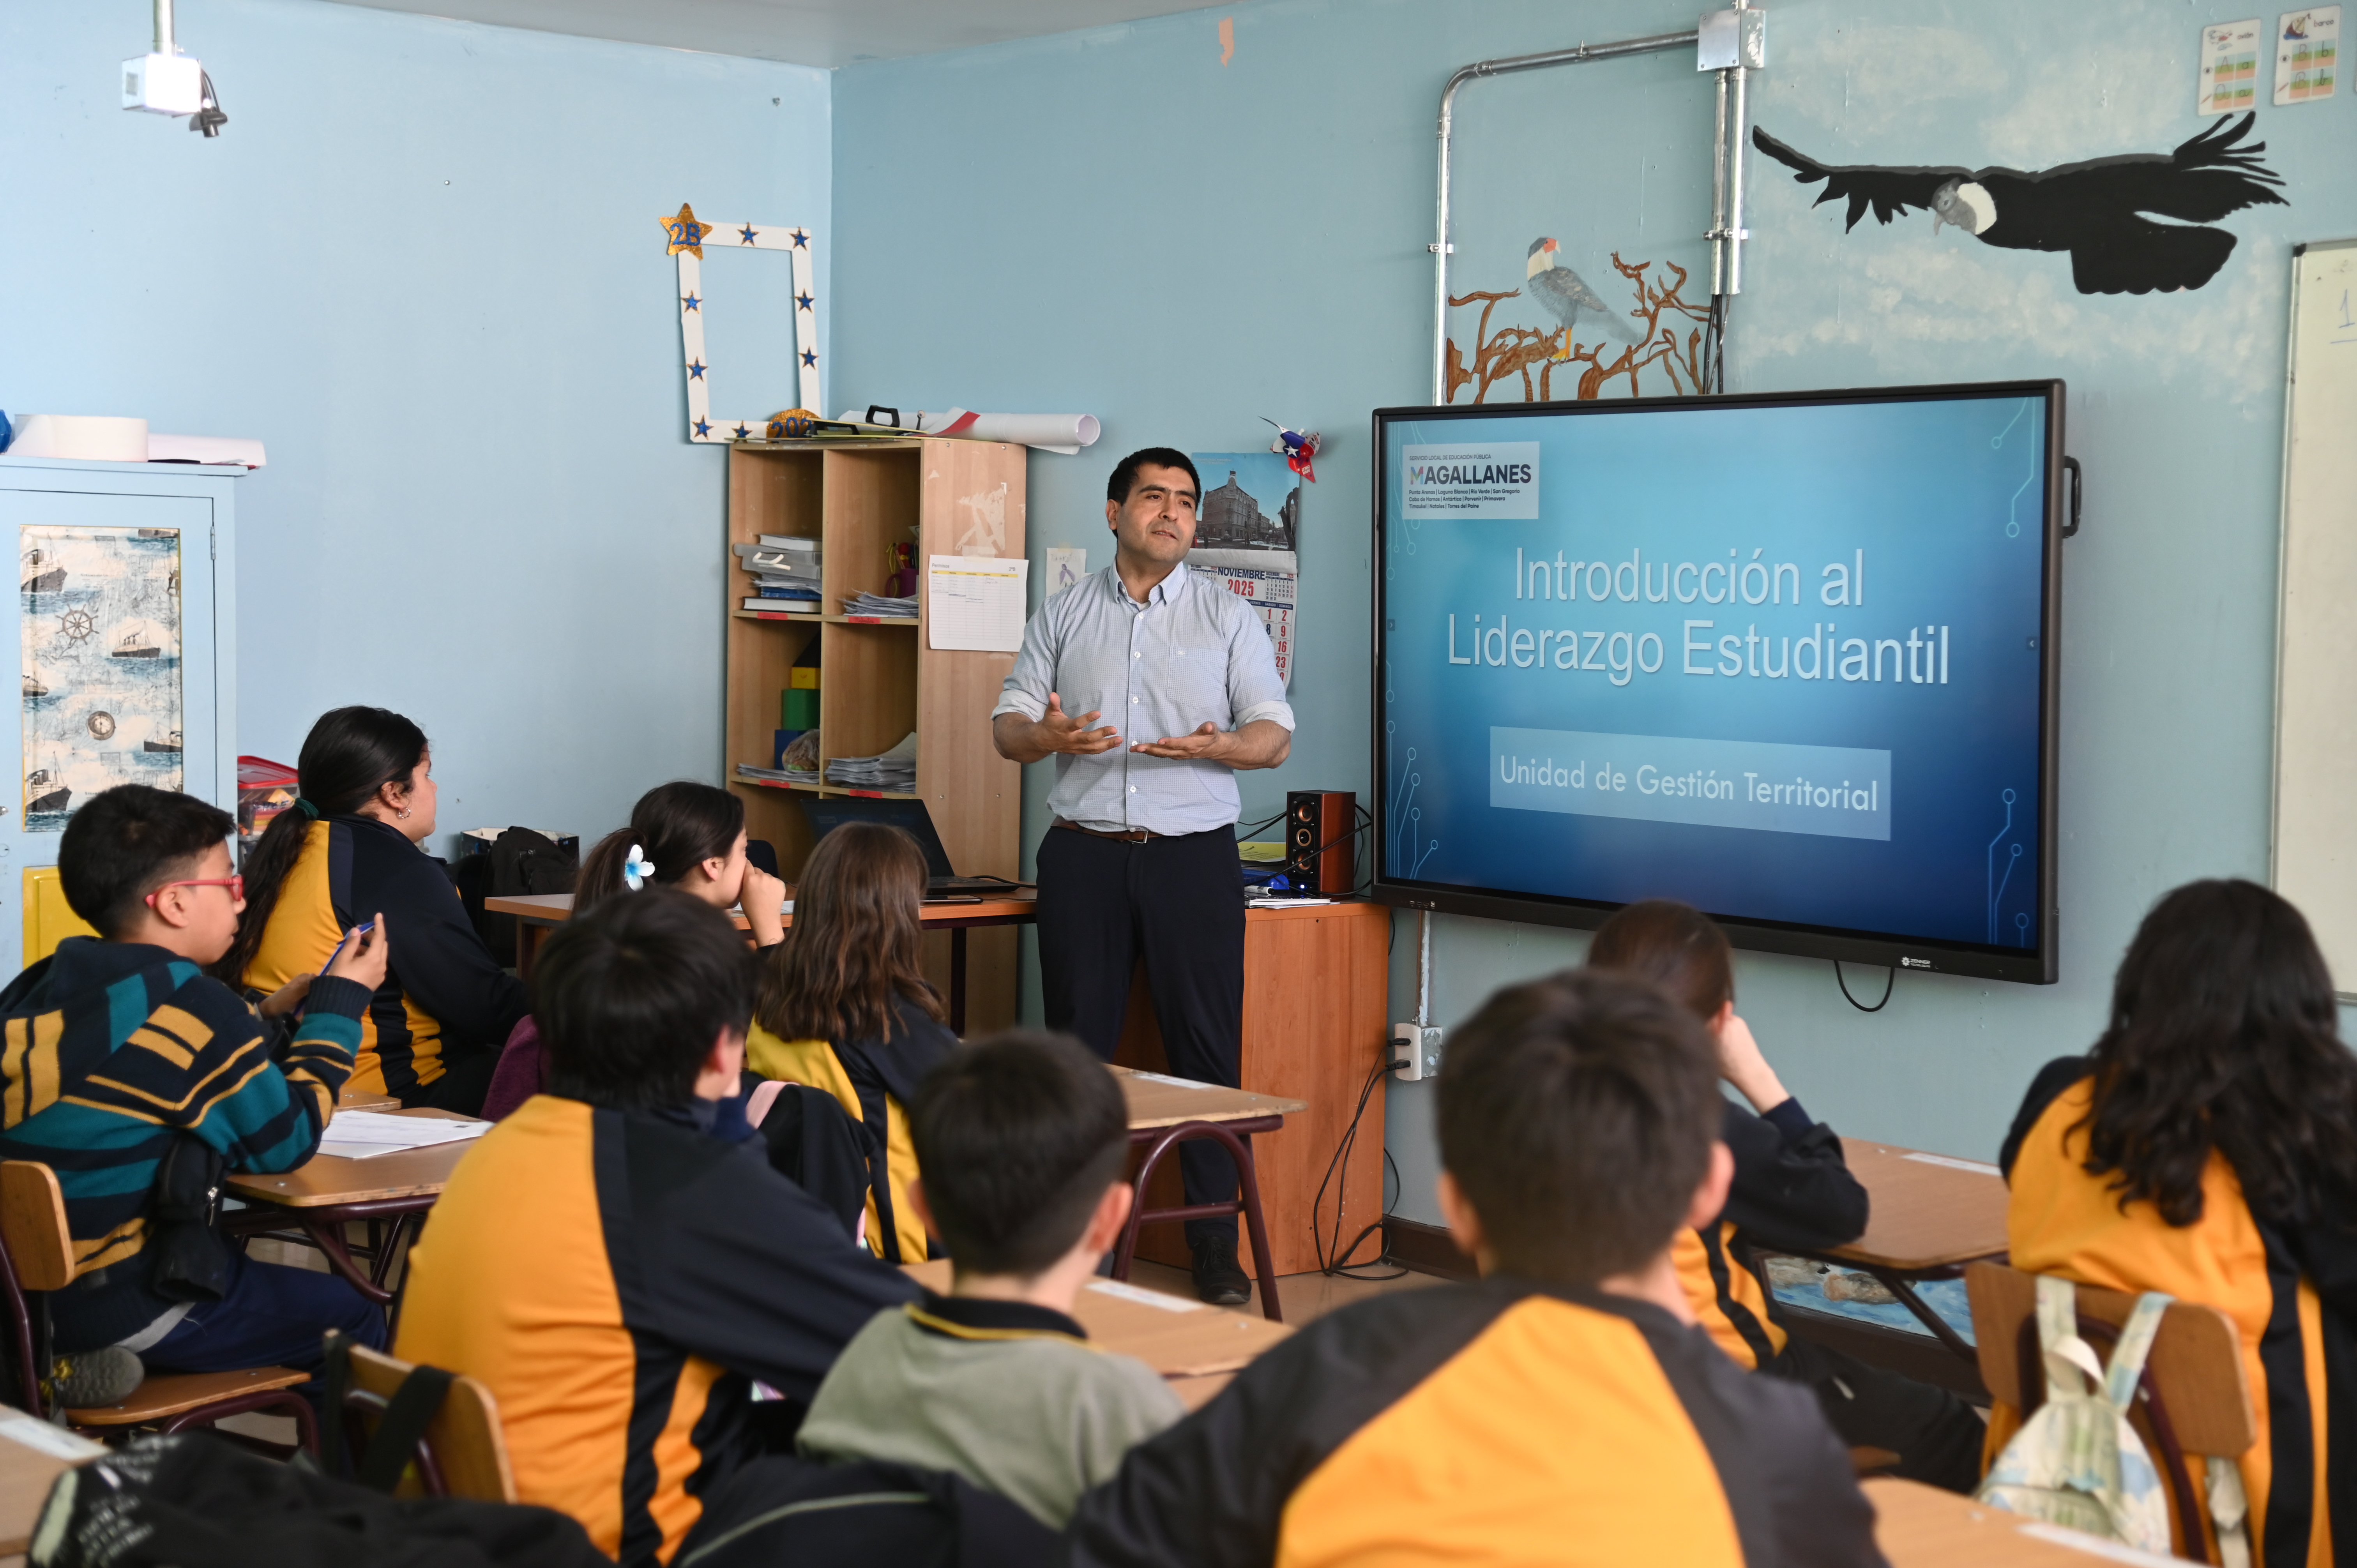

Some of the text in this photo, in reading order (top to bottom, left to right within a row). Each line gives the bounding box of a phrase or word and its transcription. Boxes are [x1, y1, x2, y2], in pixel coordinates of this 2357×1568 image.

[2313, 19, 2334, 28] barco
[2299, 41, 2329, 61] B b
[670, 222, 701, 246] 2B
[772, 417, 812, 438] 202
[1410, 464, 1531, 485] MAGALLANES
[1218, 567, 1265, 580] NOVIEMBRE
[1516, 547, 1863, 606] Introducción al
[1228, 579, 1254, 597] 2025
[1267, 608, 1287, 622] 1 2
[1266, 623, 1286, 637] 8 9
[1278, 641, 1287, 653] 16
[1449, 613, 1948, 686] Liderazgo Estudiantil
[1276, 656, 1286, 668] 23
[1500, 755, 1877, 811] Unidad de Gestión Territorial
